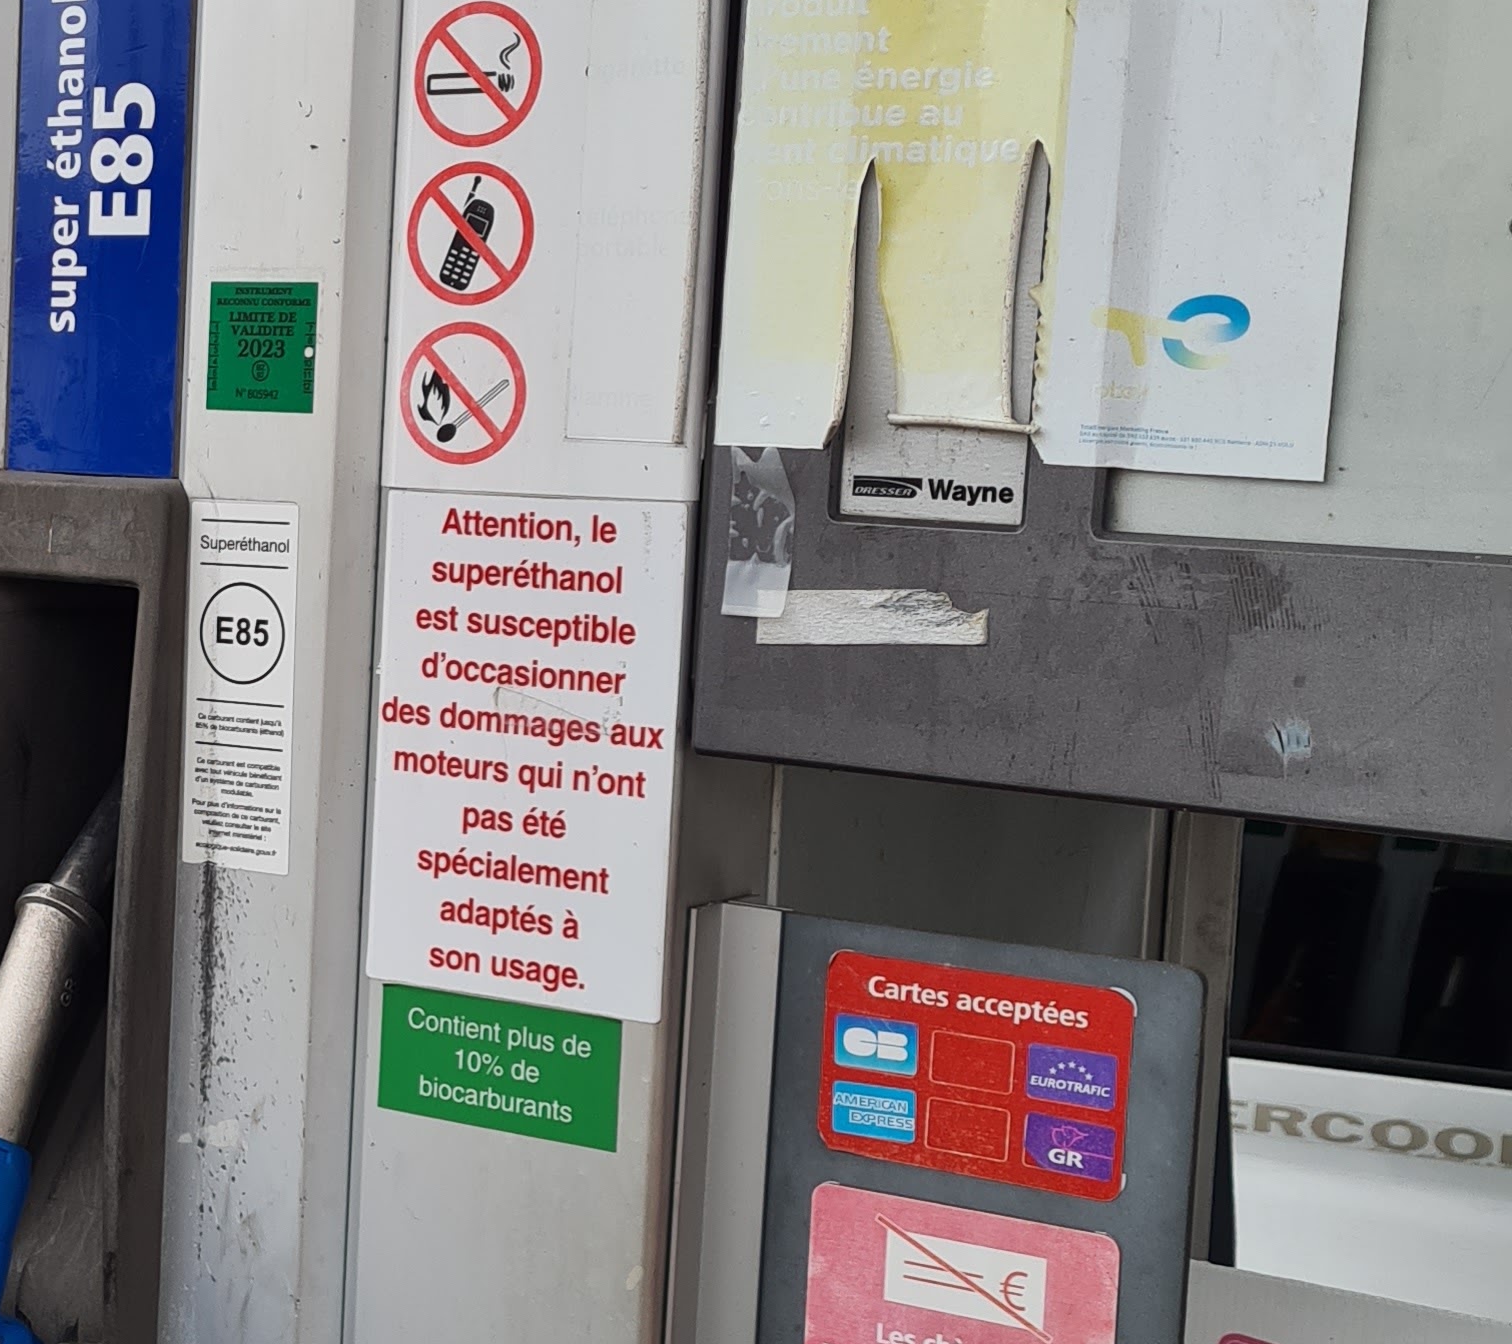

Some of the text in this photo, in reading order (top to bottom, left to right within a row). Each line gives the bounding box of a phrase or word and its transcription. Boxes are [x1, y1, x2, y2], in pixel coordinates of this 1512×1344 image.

[88, 83, 155, 236] E85
[50, 196, 87, 332] super
[229, 312, 296, 323] LIMITE DE
[231, 325, 294, 336] VALIDITE
[238, 339, 285, 358] 2023
[854, 478, 1014, 506] DRESSER Wayne
[200, 535, 289, 553] Superéthanol
[442, 508, 617, 547] Attention, le
[432, 559, 622, 594] superéthanol
[216, 616, 269, 647] E85
[416, 606, 636, 647] est susceptible
[422, 652, 626, 694] d'occasionner
[382, 696, 664, 749] des dommages aux
[394, 751, 646, 798] moteurs qui n'ont
[462, 807, 566, 838] pas été
[418, 850, 609, 894] spécialement
[440, 898, 552, 935] adaptés
[429, 947, 584, 992] son usage.
[868, 976, 1088, 1028] Cartes acceptées
[408, 1007, 554, 1052] Contient plus
[455, 1049, 504, 1076] 10%
[419, 1074, 572, 1123] biocarburants
[834, 1092, 908, 1113] AMERICAN
[1030, 1074, 1111, 1098] EUROTRAFIC
[850, 1111, 1085, 1170] EXPRESS GR
